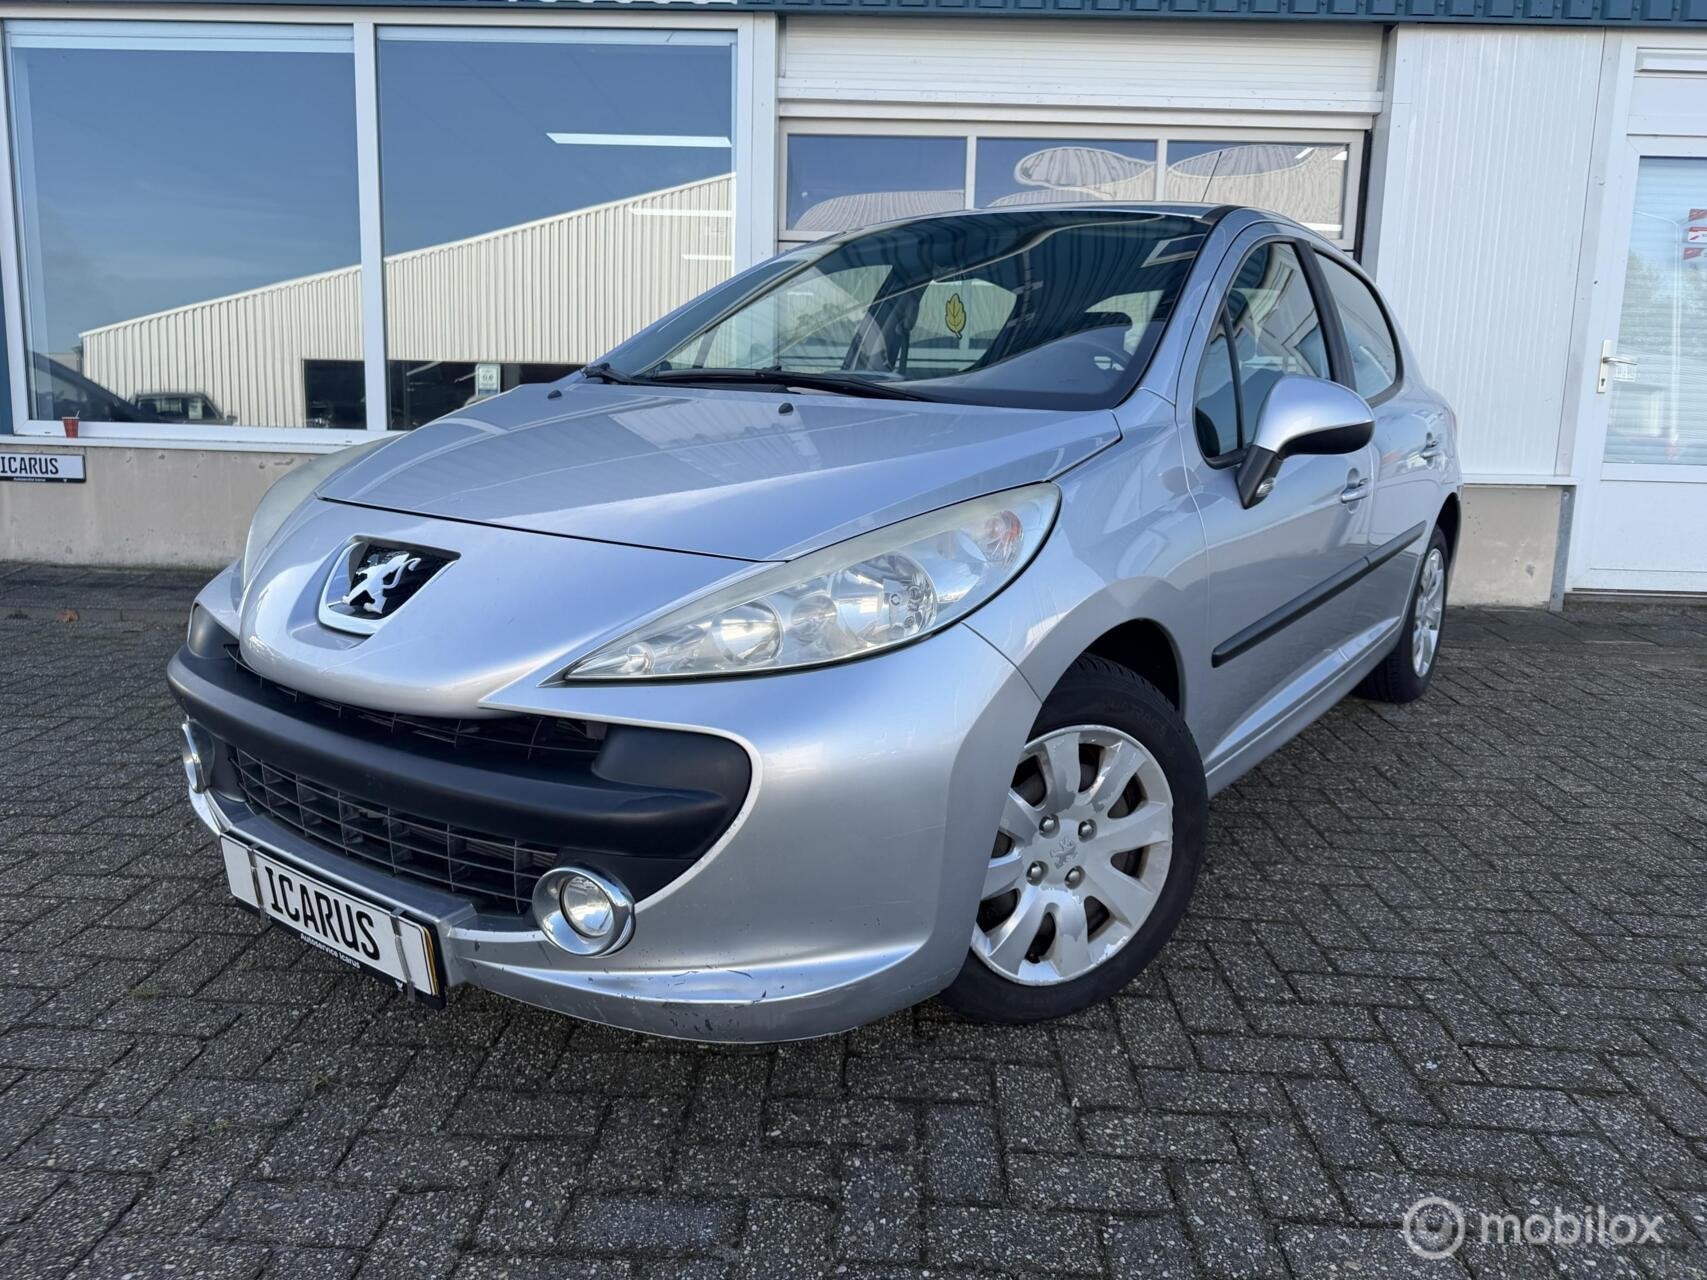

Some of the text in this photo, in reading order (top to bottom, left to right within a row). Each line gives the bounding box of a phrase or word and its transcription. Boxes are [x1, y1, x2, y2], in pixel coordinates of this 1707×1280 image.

[1, 456, 59, 475] ICARUS
[265, 866, 380, 961] ICARUS
[300, 933, 361, 969] Autoservice Icarus
